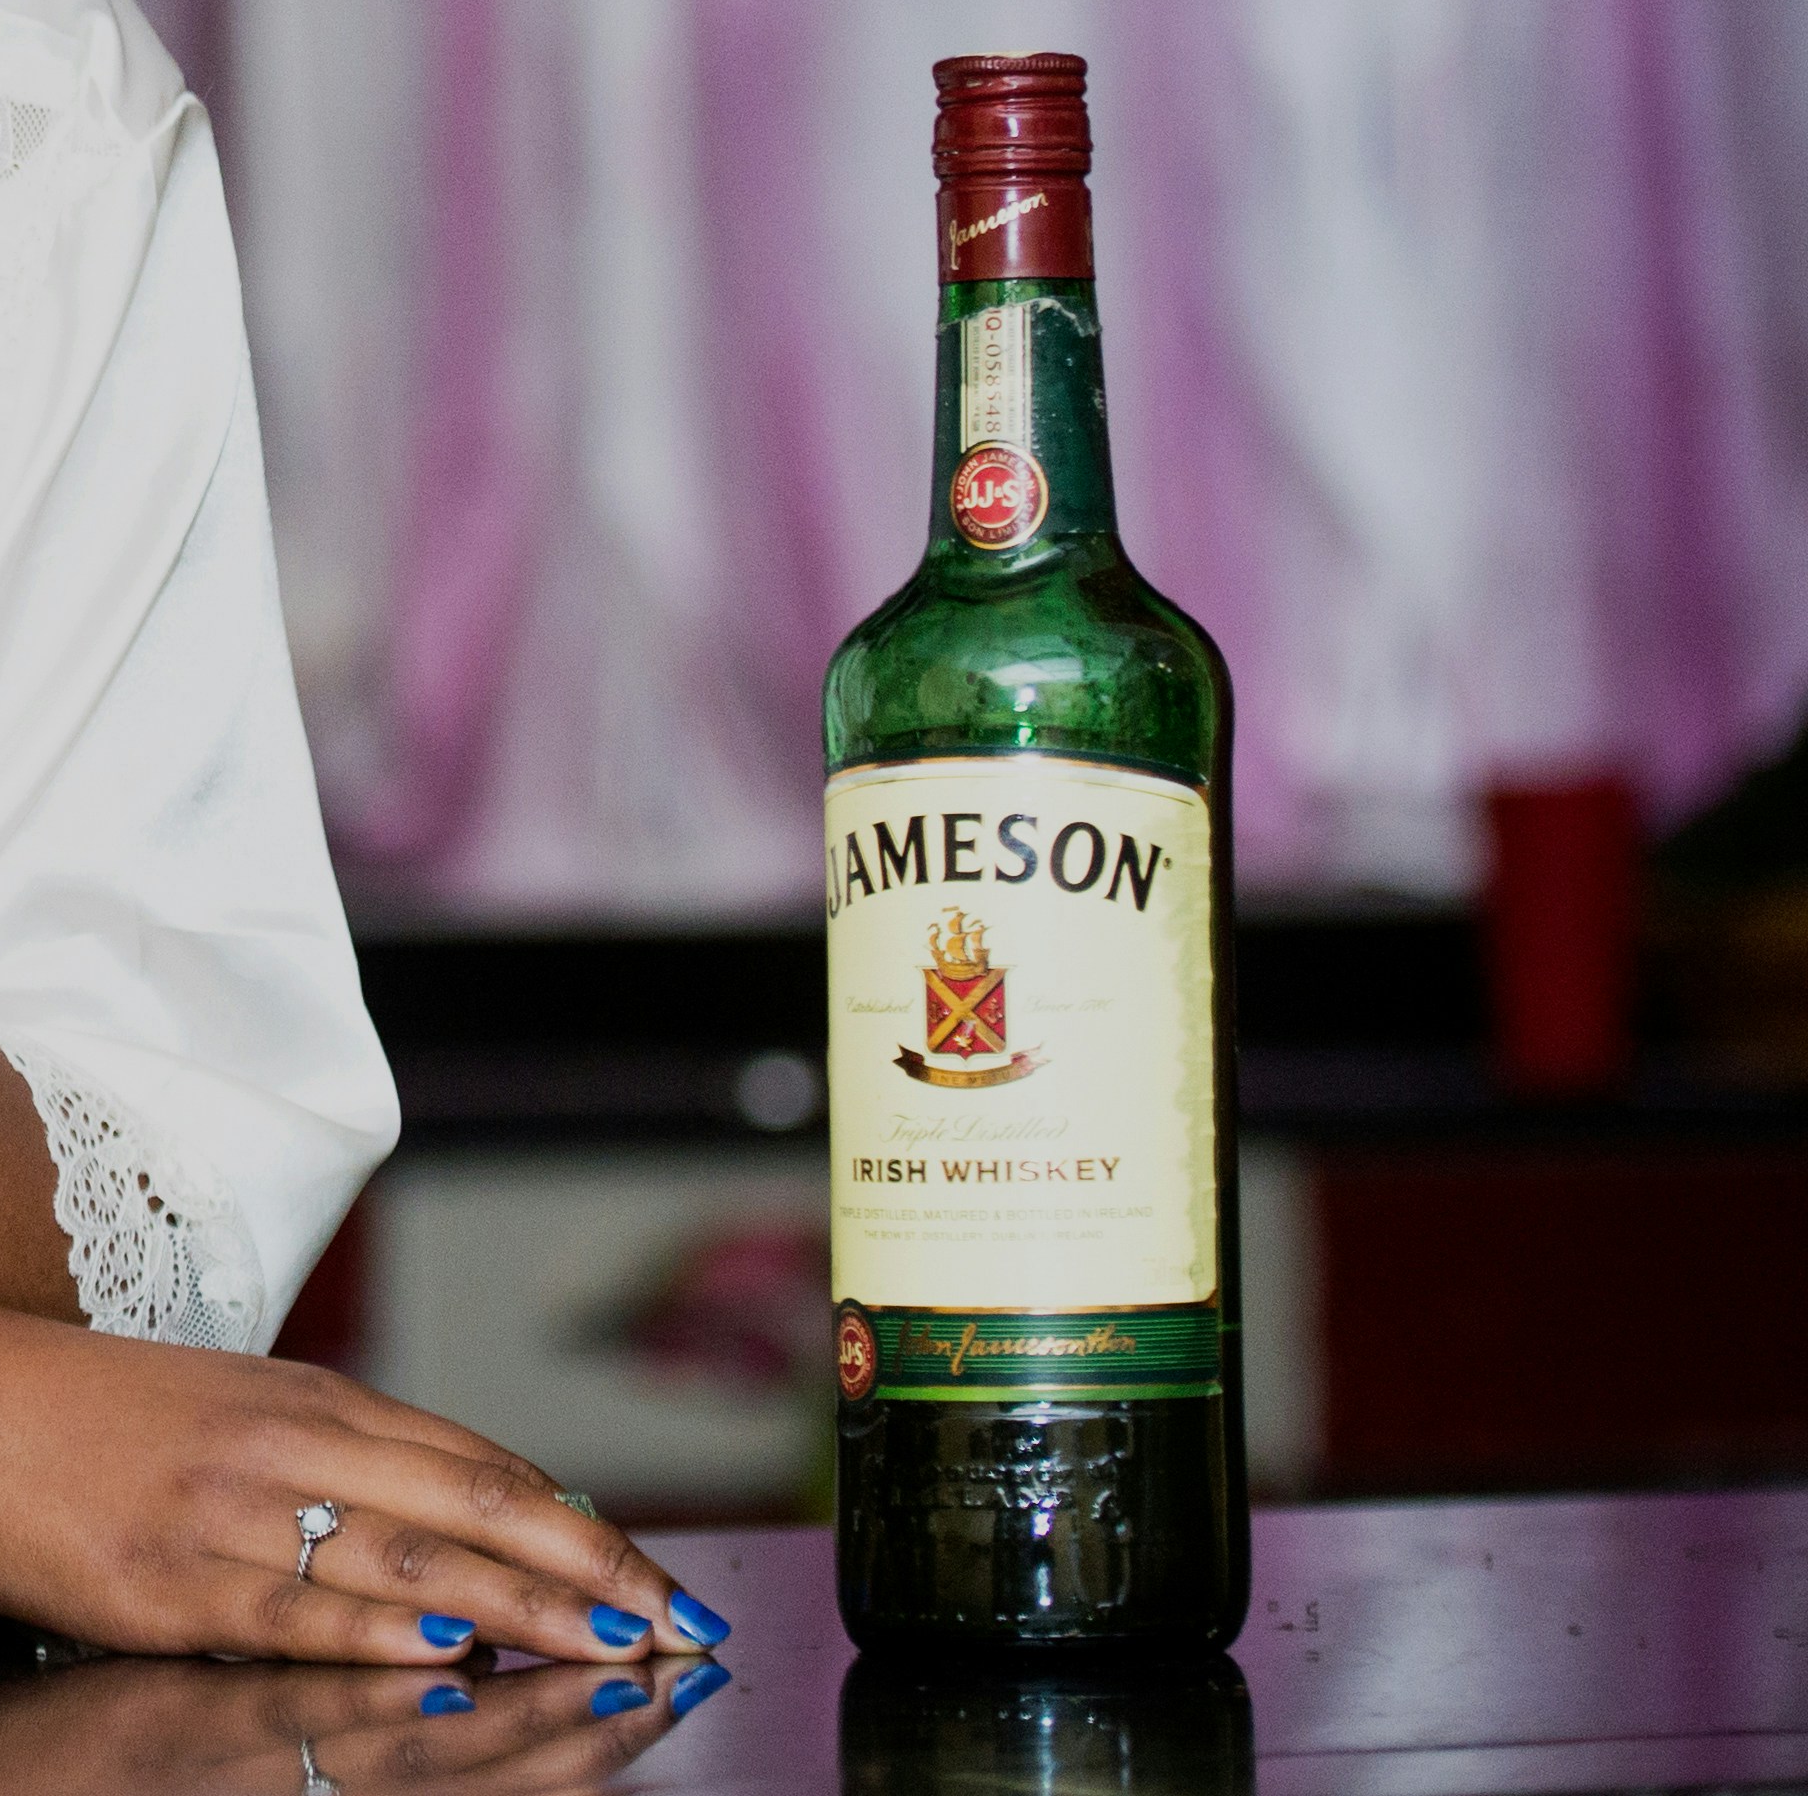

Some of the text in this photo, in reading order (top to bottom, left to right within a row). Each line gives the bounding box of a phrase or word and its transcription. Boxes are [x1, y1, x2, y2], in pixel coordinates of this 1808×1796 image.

[956, 458, 979, 493] JOHN
[963, 479, 1021, 509] JJ&S
[827, 812, 1163, 920] JAMESON
[879, 1113, 1070, 1152] Triple Distilled
[852, 1157, 1121, 1183] IRISH WHISKEY
[923, 1209, 989, 1221] MATURED
[993, 1209, 1002, 1221] &
[1005, 1208, 1074, 1221] BOTTLED
[1077, 1208, 1092, 1219] IN
[1094, 1205, 1154, 1219] IRELAND
